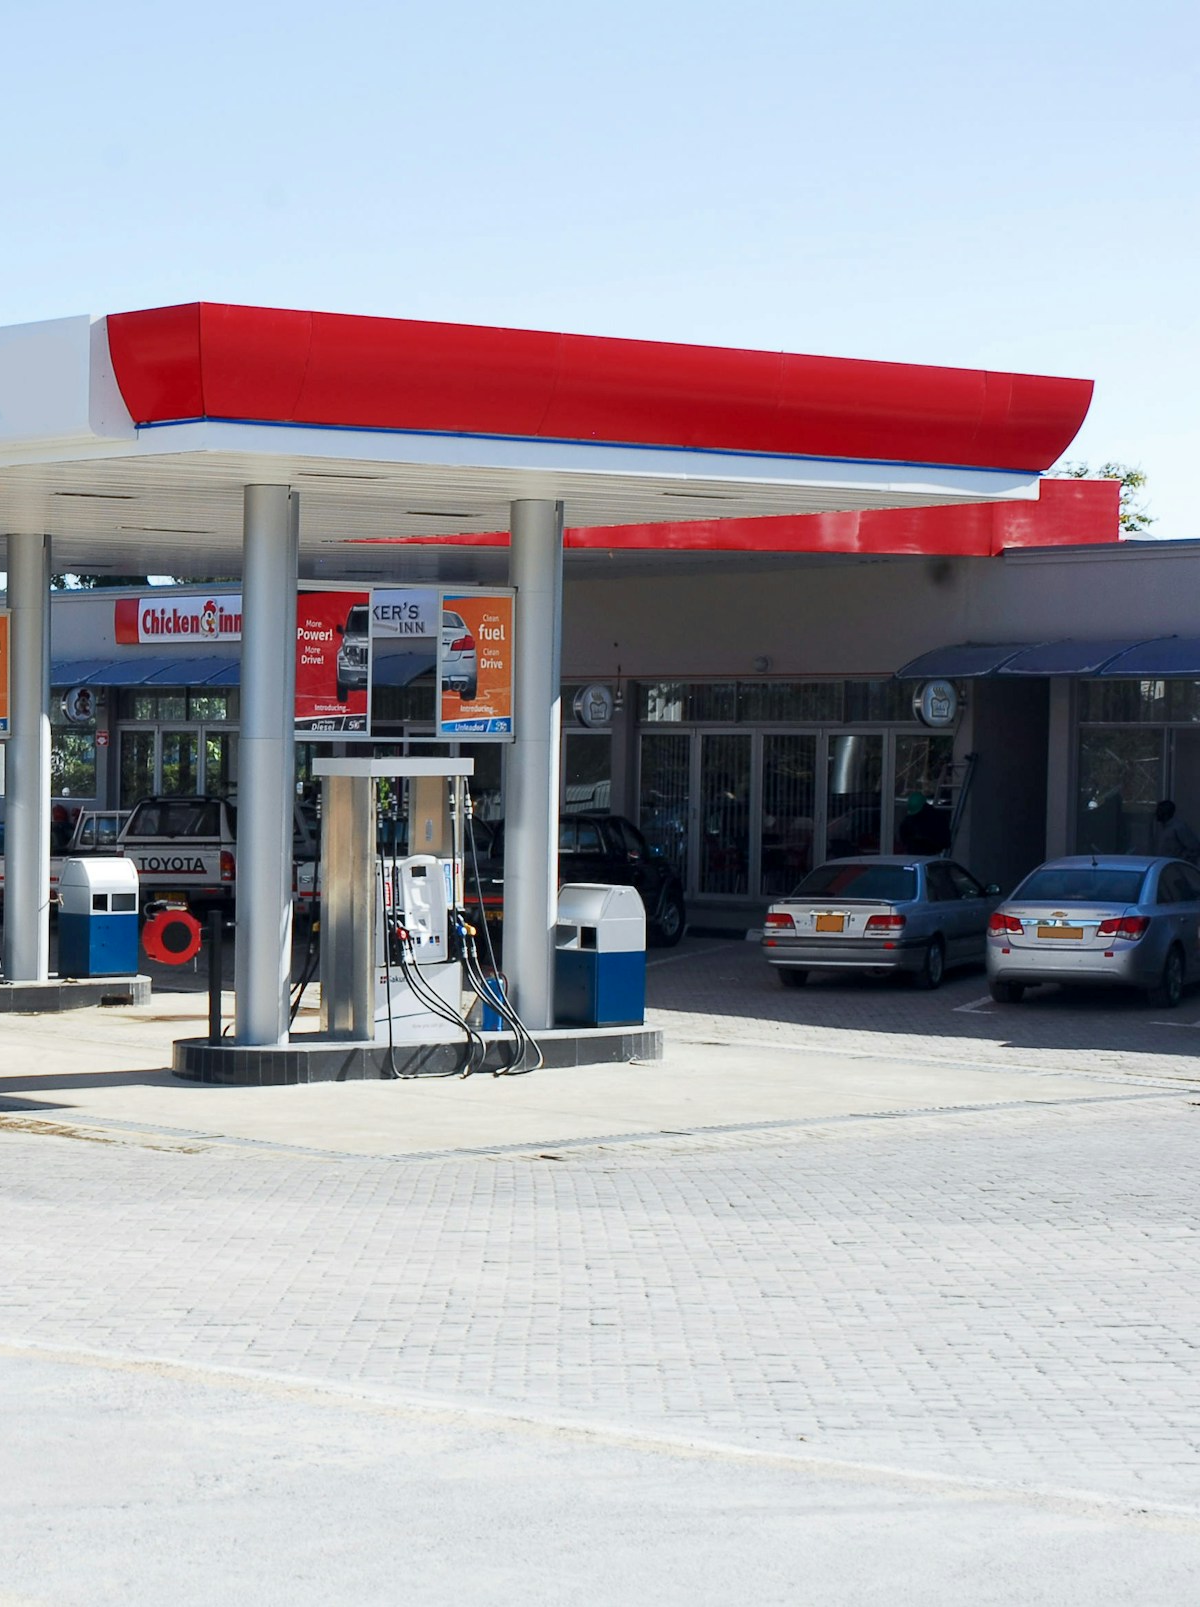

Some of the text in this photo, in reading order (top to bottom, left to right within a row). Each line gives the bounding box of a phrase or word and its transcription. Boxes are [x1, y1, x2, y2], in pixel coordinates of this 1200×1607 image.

[142, 607, 242, 634] Chicken inn
[482, 613, 500, 622] Clean
[305, 619, 323, 628] More
[399, 621, 424, 634] INN
[297, 627, 333, 641] Power!
[478, 623, 506, 640] fuel
[304, 645, 321, 654] More
[482, 647, 500, 656] Clean
[301, 654, 324, 664] Drive!
[480, 657, 503, 669] Drive
[311, 721, 336, 731] Diesel
[138, 857, 206, 870] TOYOTA
